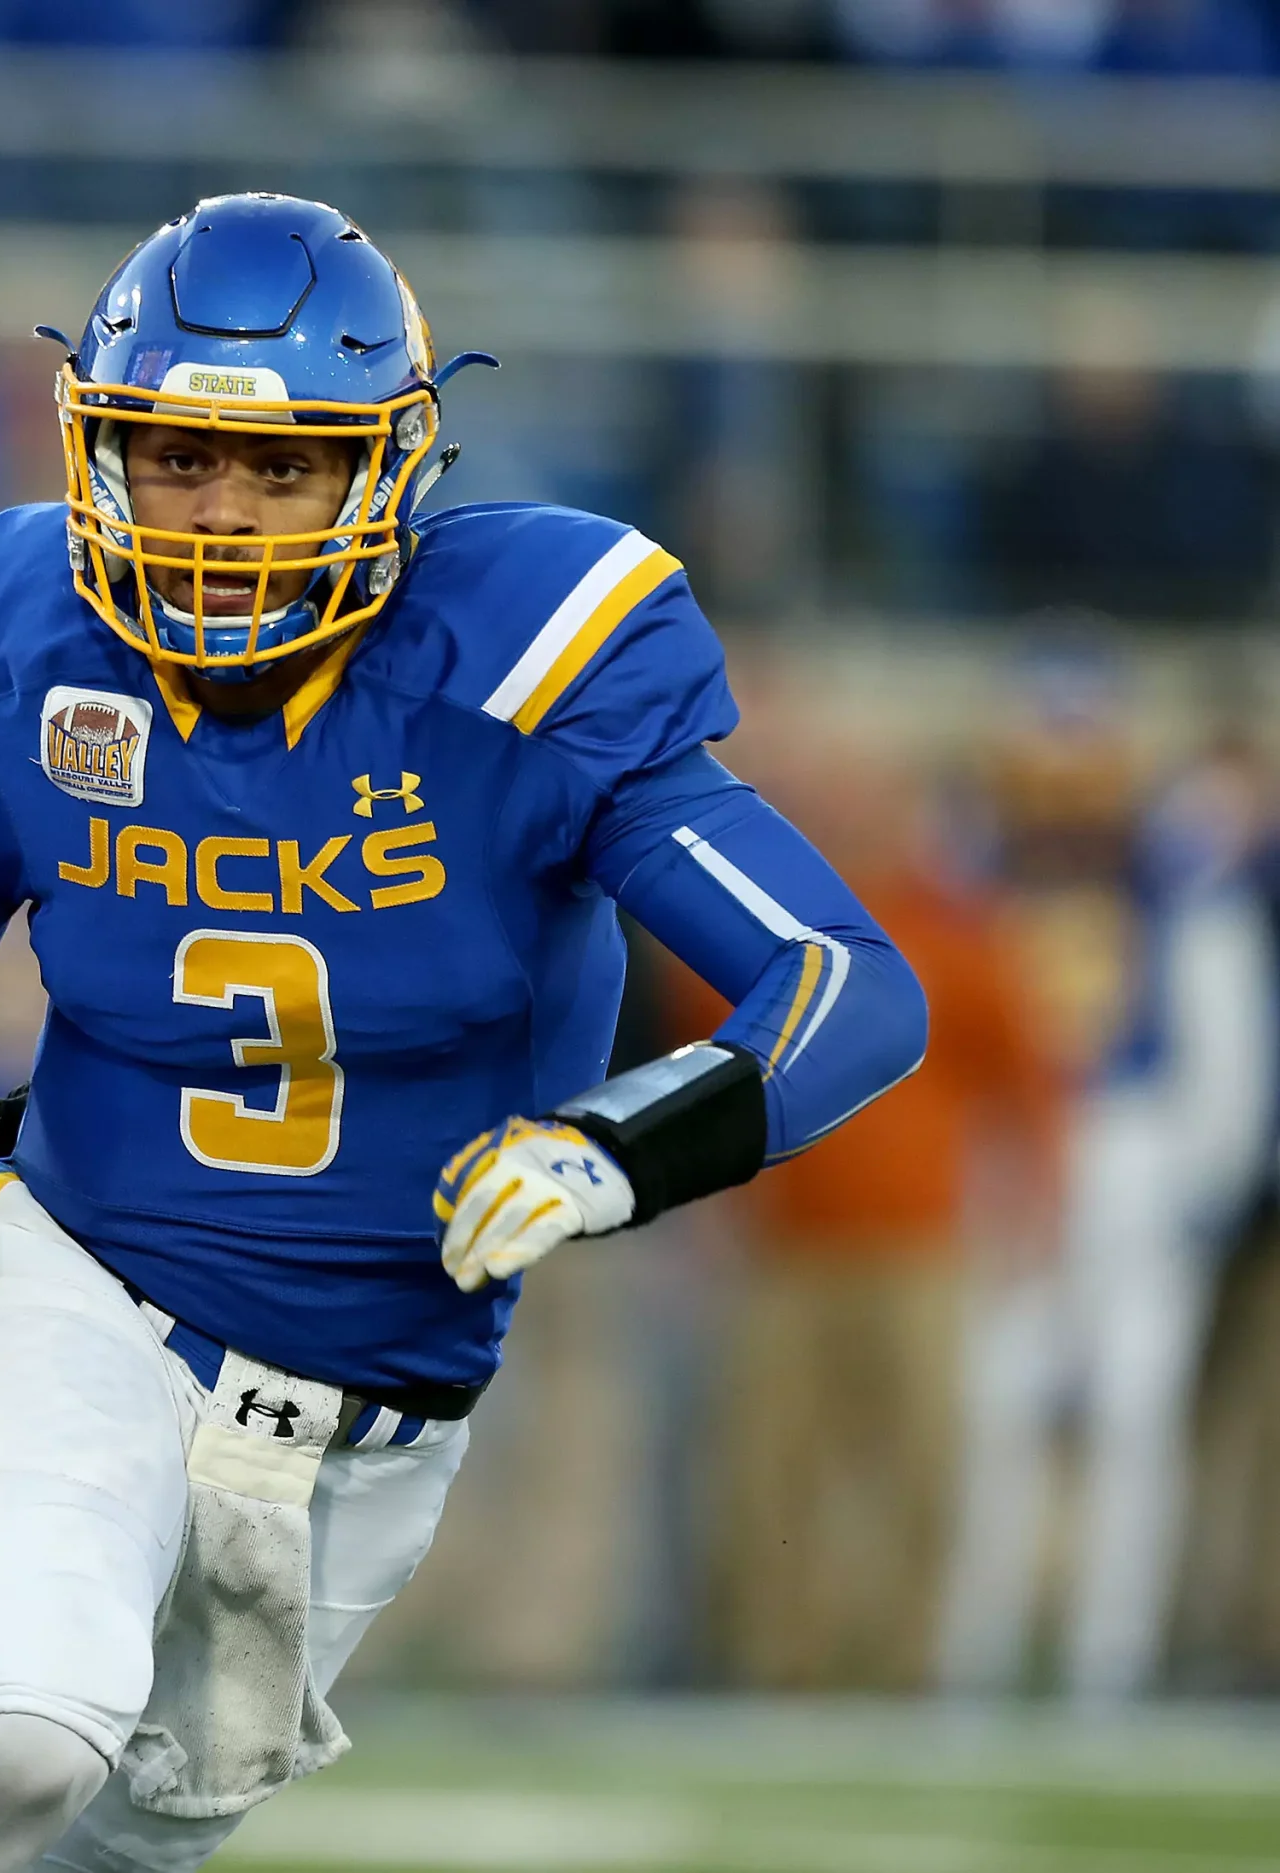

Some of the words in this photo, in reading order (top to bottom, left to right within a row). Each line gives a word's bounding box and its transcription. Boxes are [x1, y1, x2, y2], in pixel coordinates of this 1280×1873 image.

[189, 373, 257, 396] STATE
[87, 463, 128, 540] Riddel
[48, 719, 140, 782] VALLEY
[50, 769, 94, 783] MISSOURI
[98, 778, 133, 790] VALLEY
[87, 786, 133, 799] CONFERENCE
[58, 815, 446, 914] JACKS
[173, 928, 345, 1177] 3
